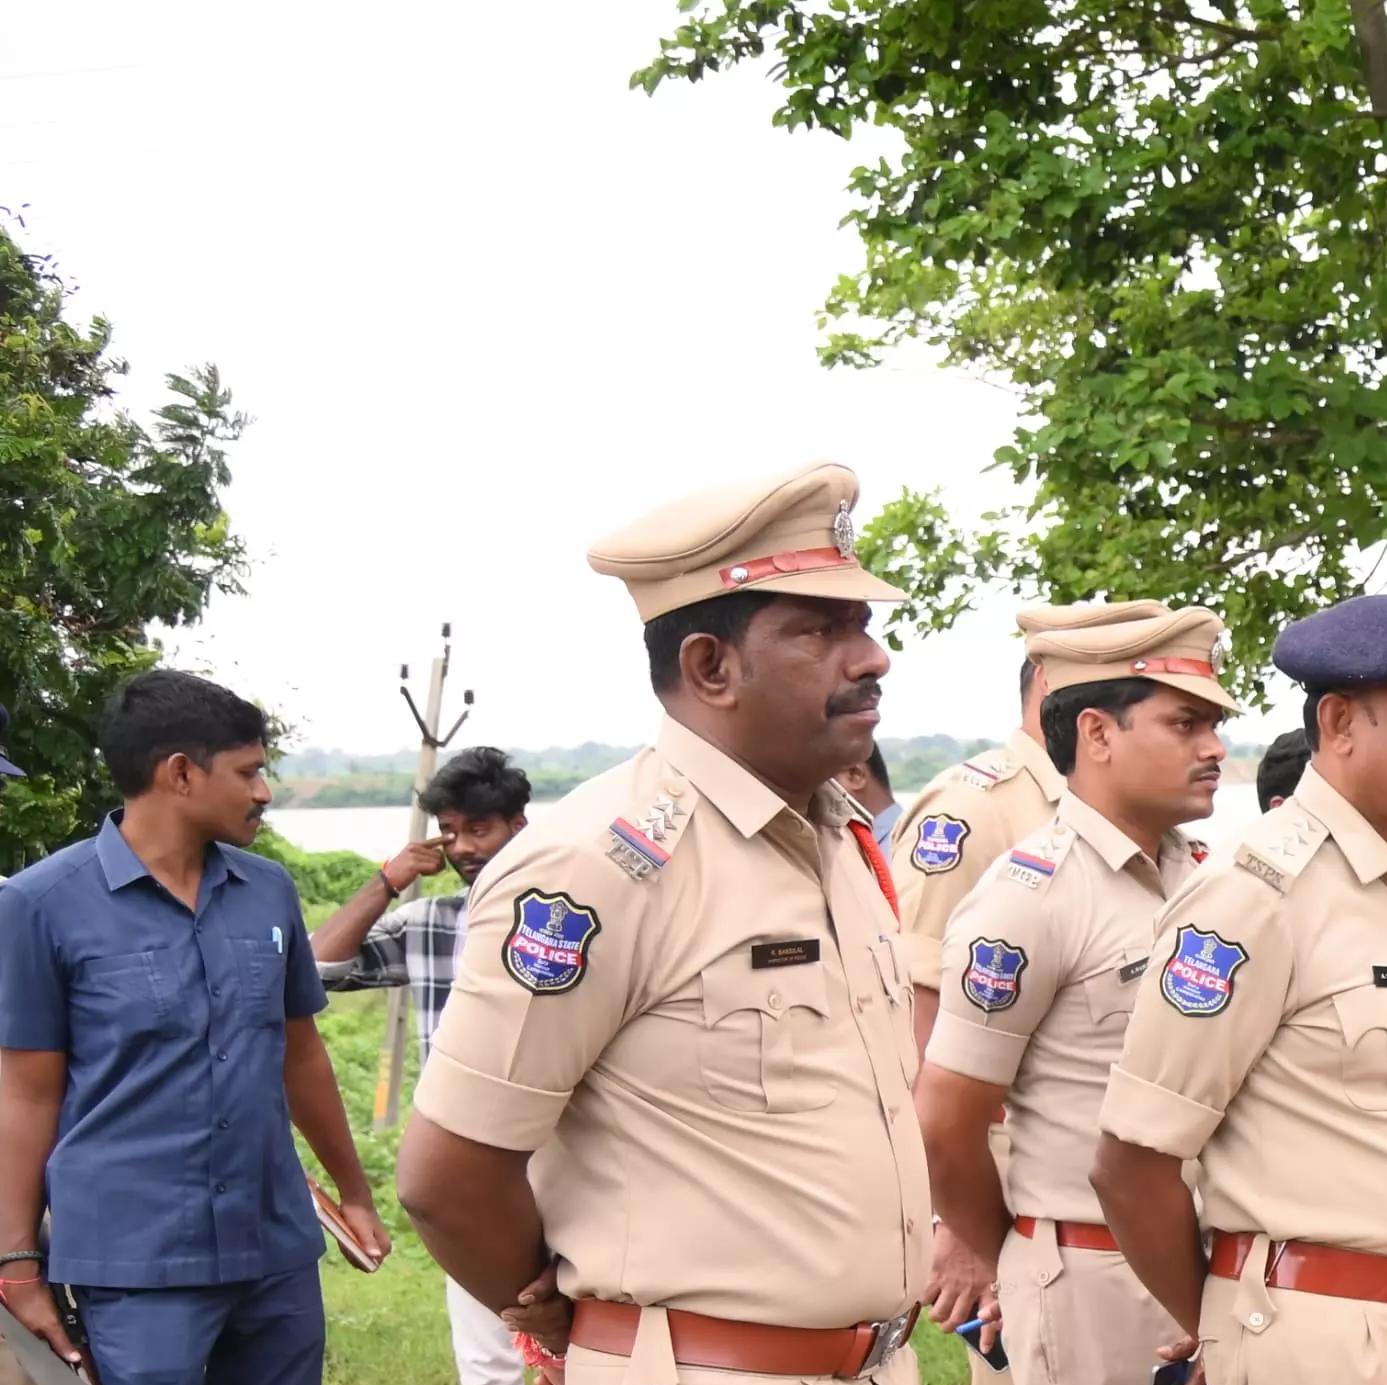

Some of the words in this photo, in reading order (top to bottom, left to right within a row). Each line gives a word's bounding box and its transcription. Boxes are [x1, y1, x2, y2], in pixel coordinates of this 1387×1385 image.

[514, 936, 577, 965] POLICE
[522, 924, 557, 947] TELANGANA
[559, 941, 580, 950] STATE
[969, 969, 1014, 991] POLICE
[1173, 961, 1227, 992] POLICE
